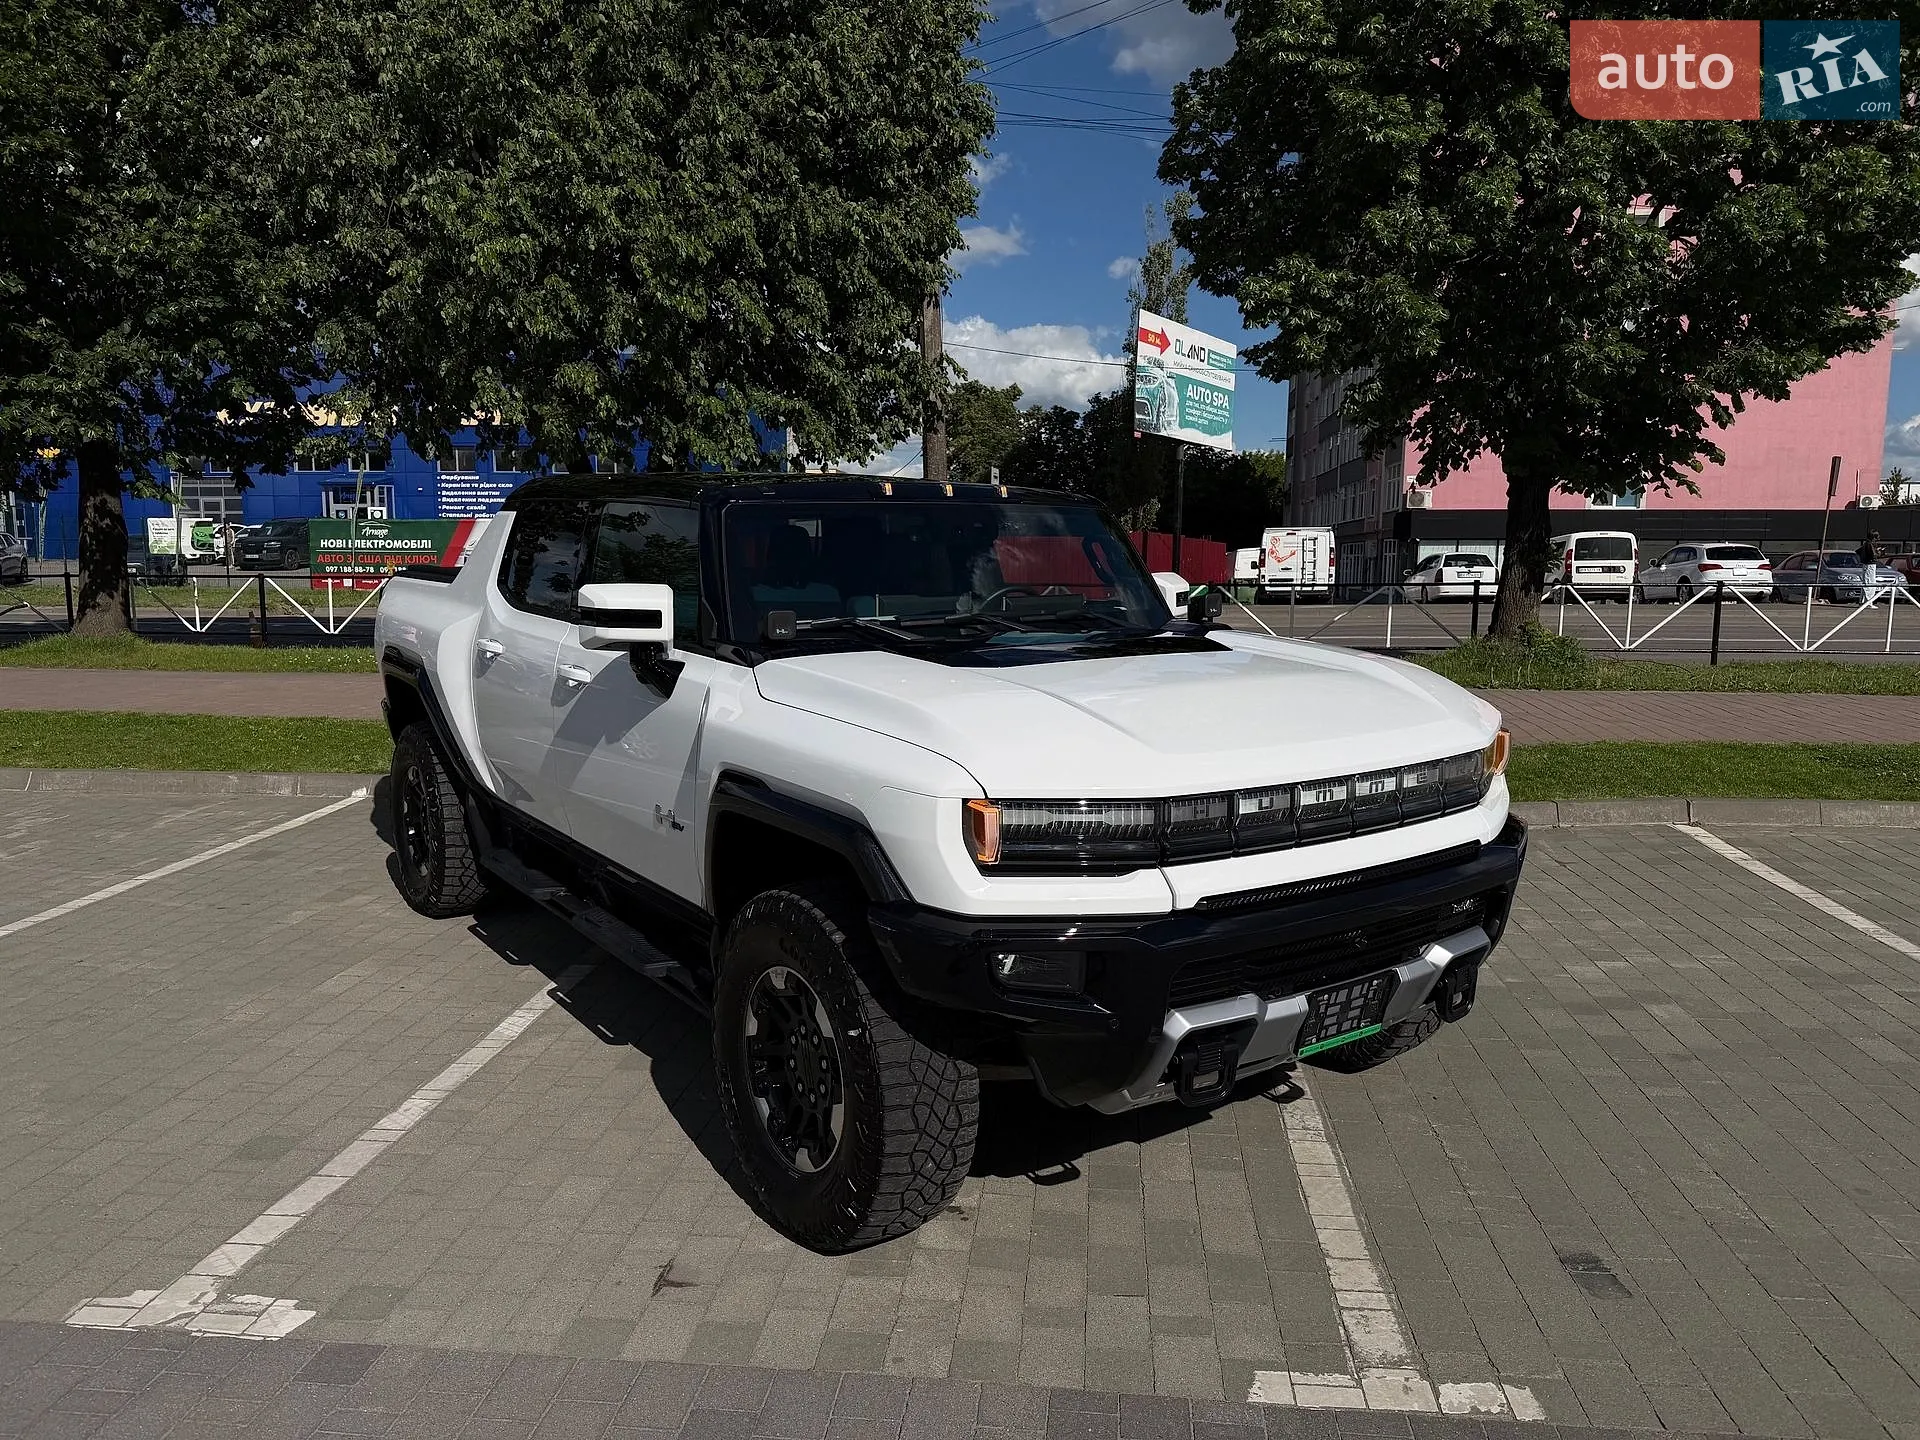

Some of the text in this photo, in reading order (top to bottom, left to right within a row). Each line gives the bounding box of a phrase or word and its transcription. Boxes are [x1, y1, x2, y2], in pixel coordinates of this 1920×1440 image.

[1148, 333, 1154, 343] 50
[1175, 339, 1206, 362] OLAND
[1187, 384, 1212, 403] AUTO
[1213, 390, 1229, 409] SPA
[362, 526, 389, 539] Arnage
[321, 539, 345, 548] НОВІ
[358, 555, 381, 563] США
[405, 555, 437, 564] КЛЮЧ
